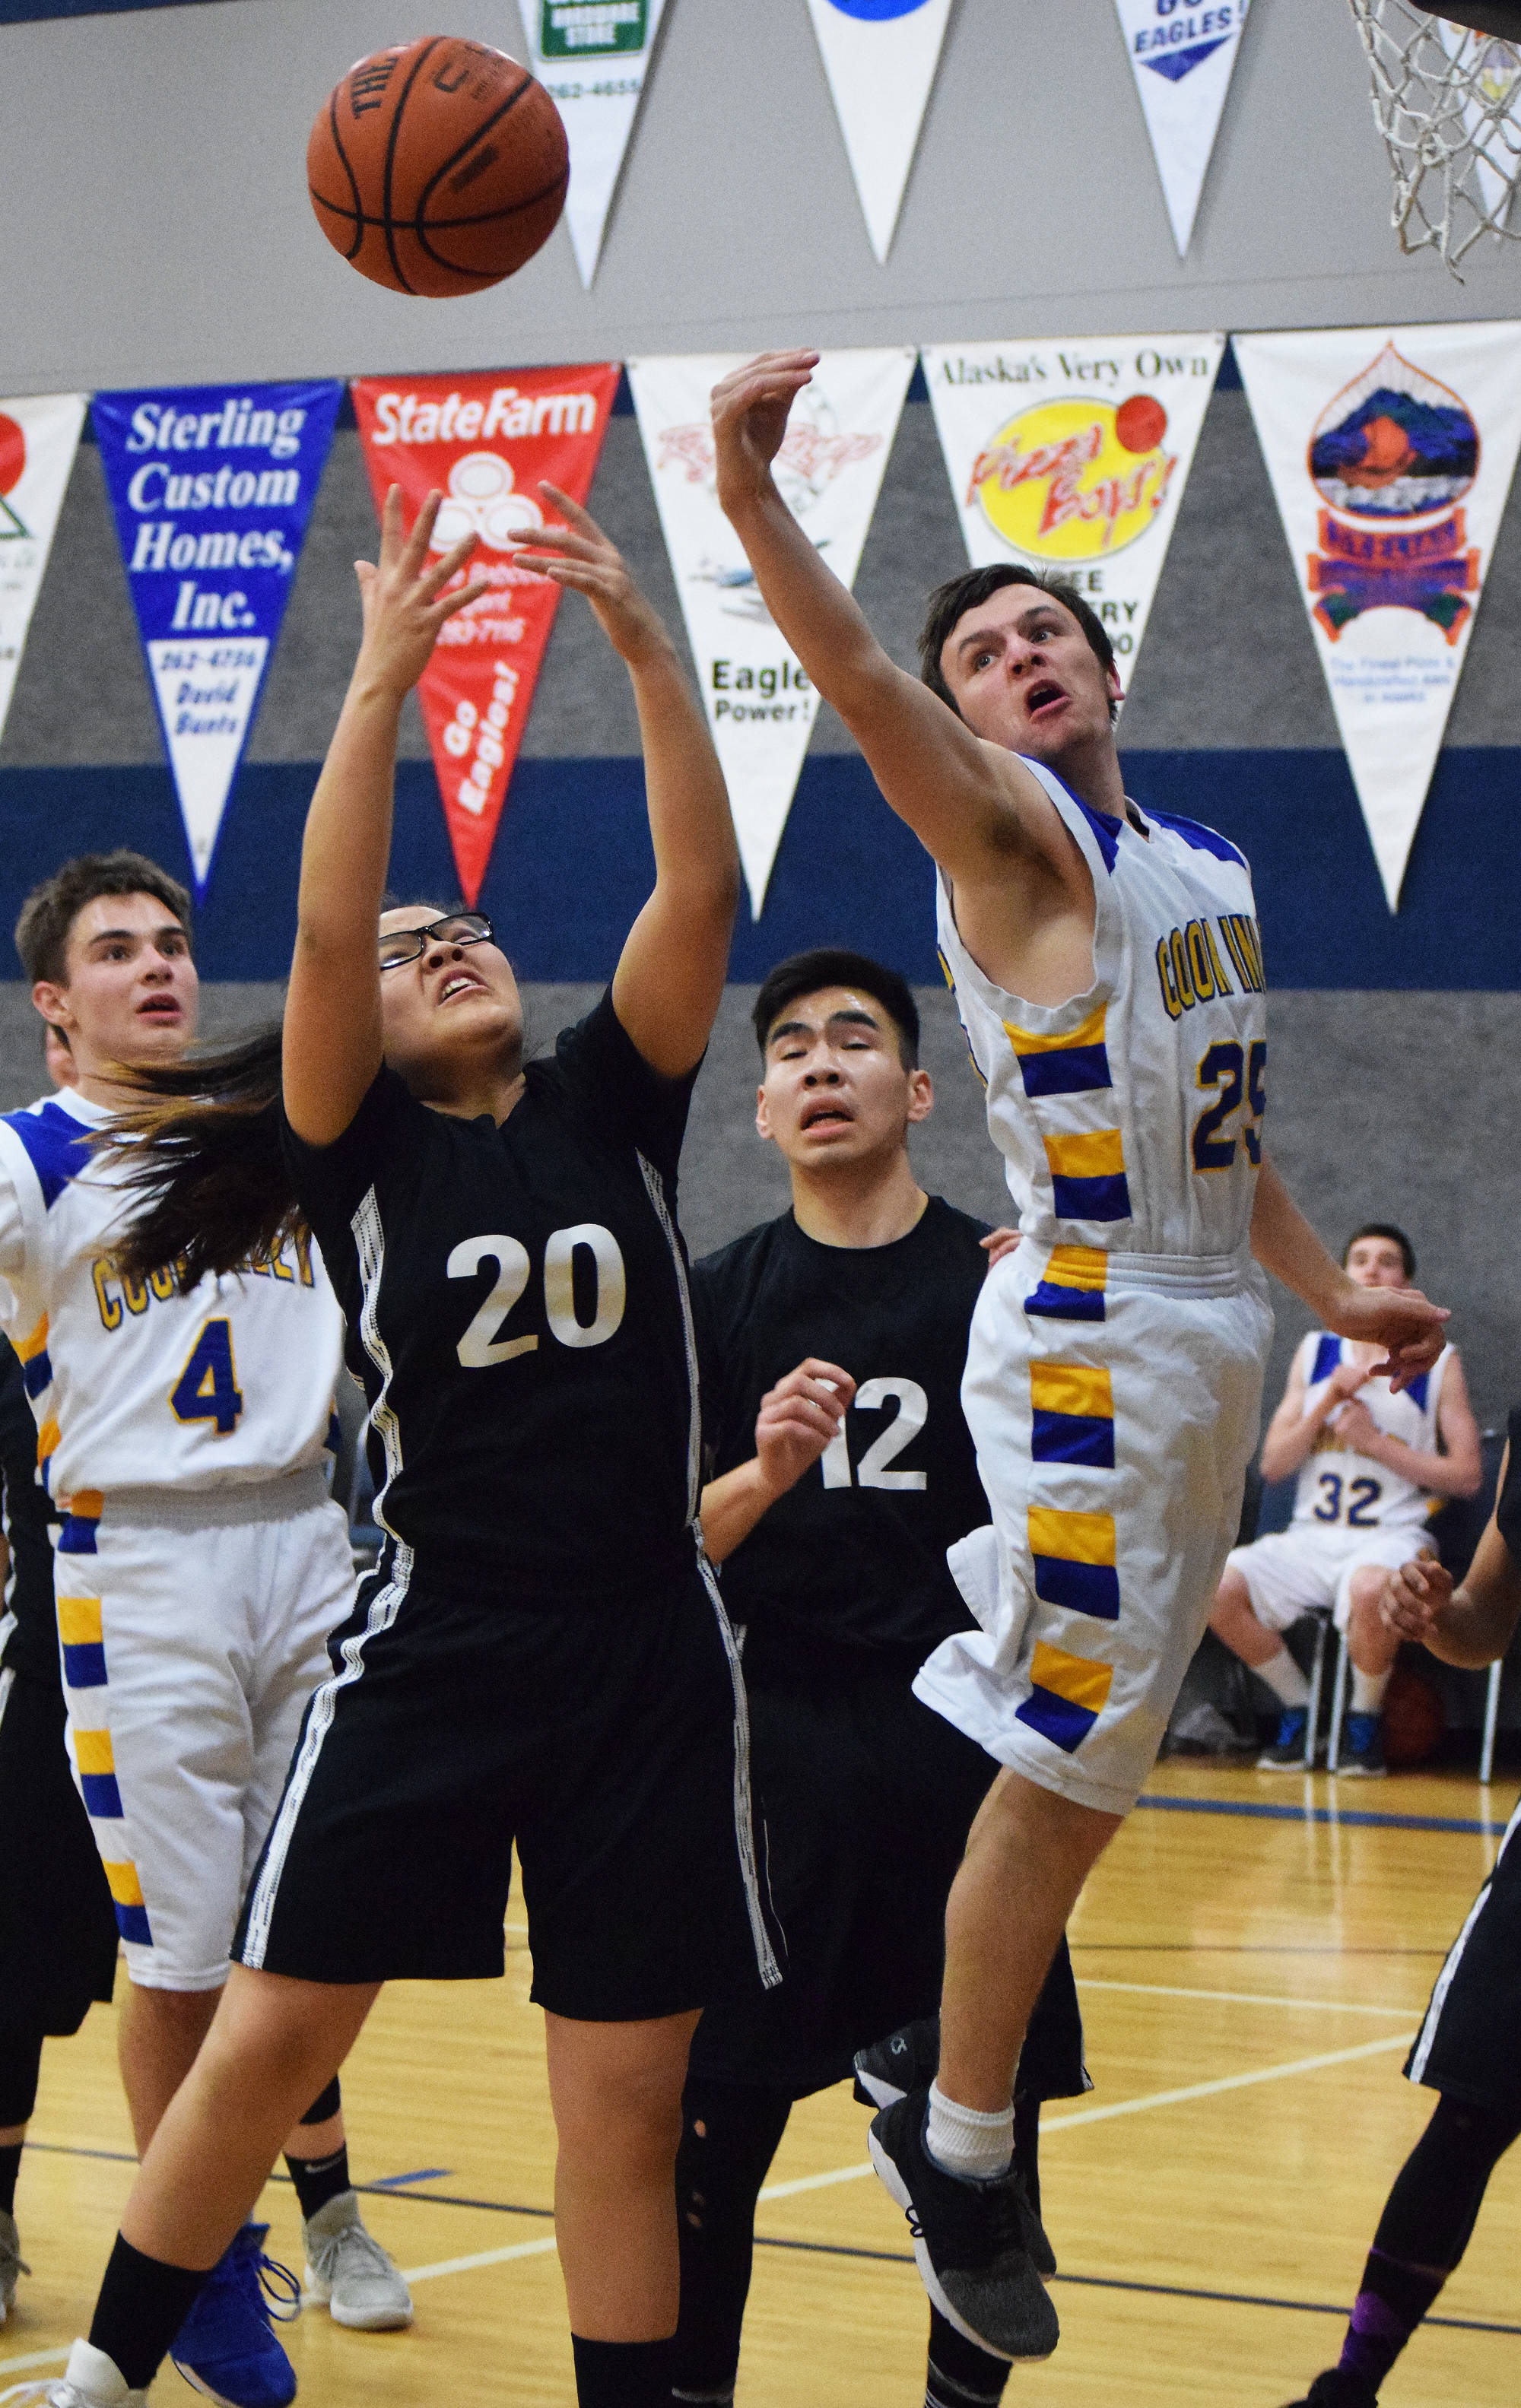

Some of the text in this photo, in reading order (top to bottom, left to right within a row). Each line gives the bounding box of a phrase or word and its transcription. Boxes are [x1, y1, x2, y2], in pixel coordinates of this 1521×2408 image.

[940, 349, 1209, 388] Alaska's Very Own
[125, 398, 307, 460] Sterling
[127, 462, 300, 513] Custom
[129, 521, 294, 576] Homes,
[171, 579, 256, 631] Inc.
[712, 658, 811, 700] Eagle
[715, 698, 810, 722] Power!
[1191, 1039, 1267, 1174] 25
[446, 1223, 627, 1368] 20
[167, 1316, 243, 1437] 4
[808, 1377, 929, 1490] 12
[1313, 1472, 1383, 1528] 32
